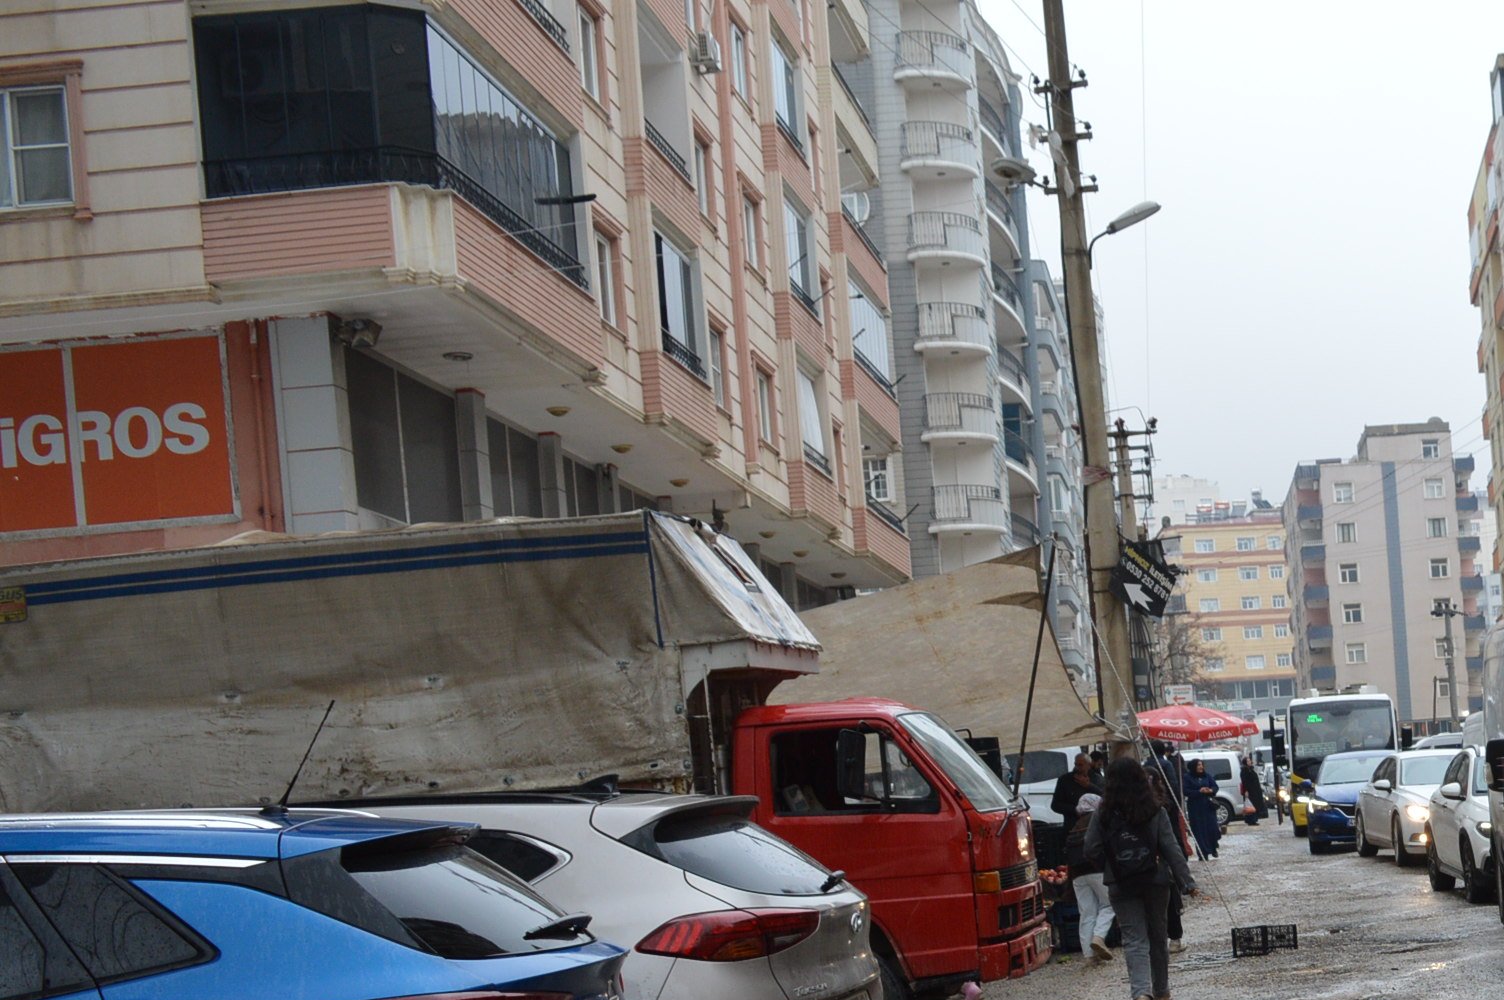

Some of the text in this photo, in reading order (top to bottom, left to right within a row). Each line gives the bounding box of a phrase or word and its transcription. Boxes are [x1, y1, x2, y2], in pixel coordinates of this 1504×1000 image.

[1126, 561, 1143, 579] 0530
[1141, 574, 1155, 590] 252
[1158, 730, 1187, 740] ALGIDA
[1208, 730, 1233, 740] ALGIDA
